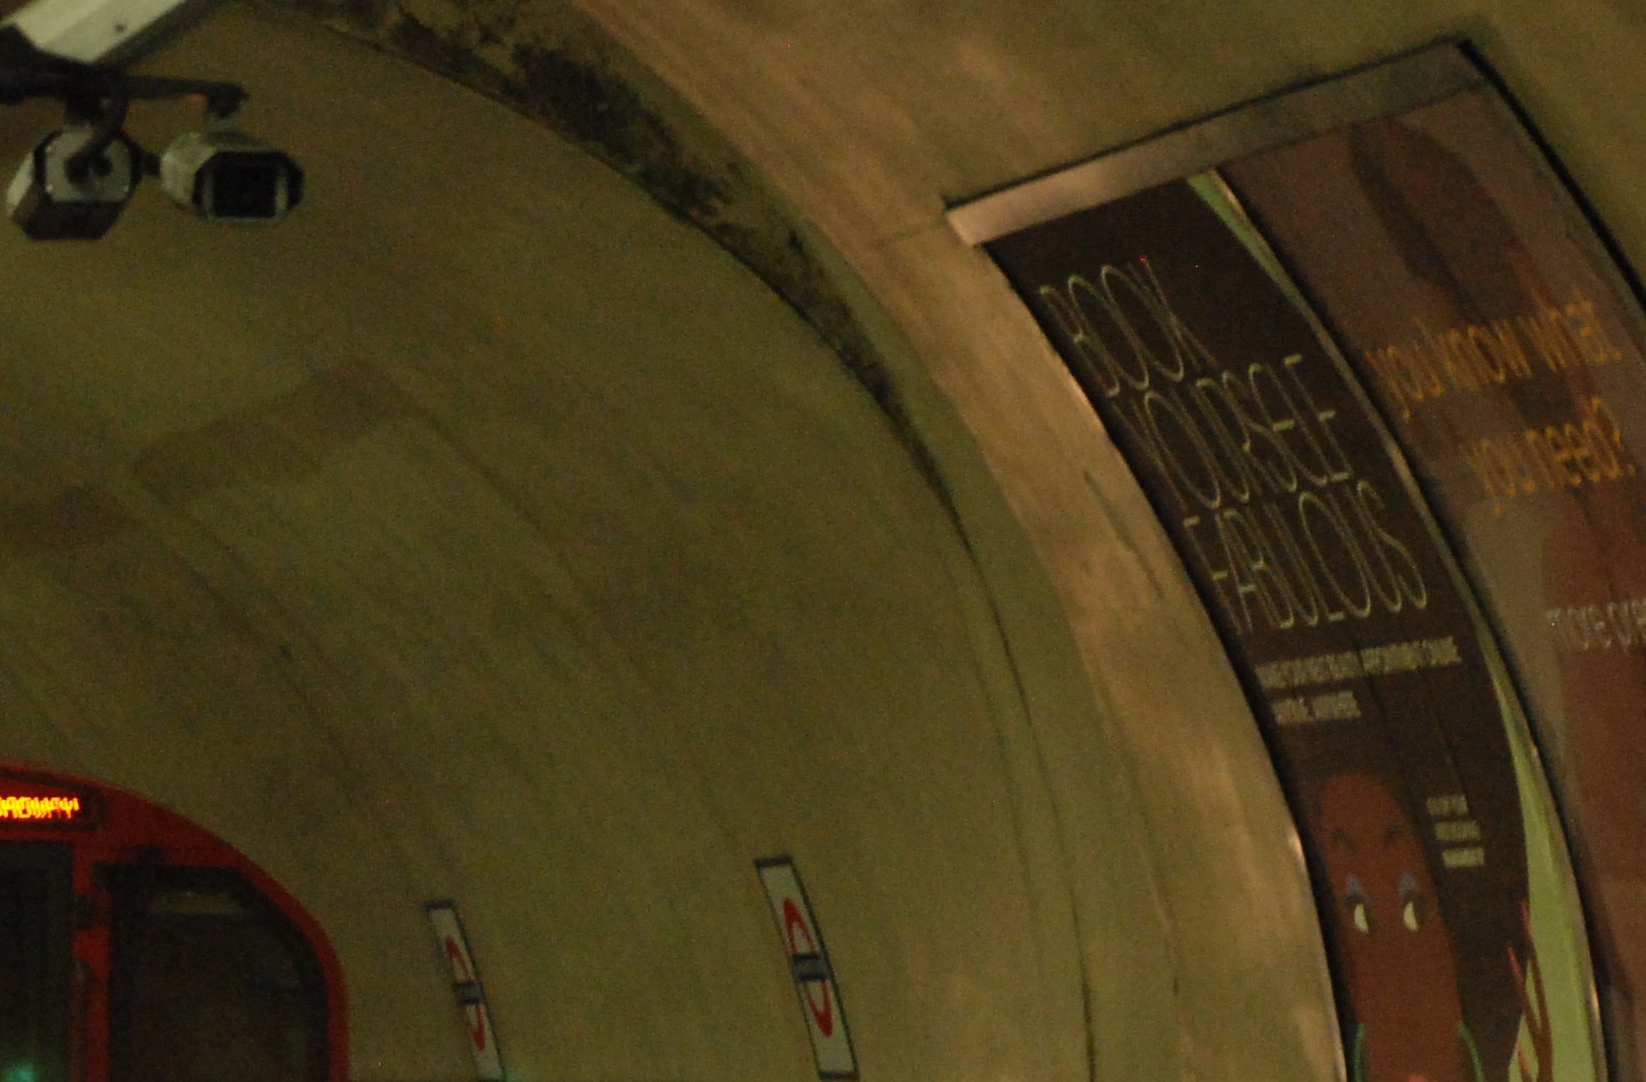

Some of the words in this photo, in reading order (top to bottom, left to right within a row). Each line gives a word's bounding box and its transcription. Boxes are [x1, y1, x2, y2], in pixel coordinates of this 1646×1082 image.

[1040, 256, 1220, 398] BOOK
[1111, 355, 1350, 508] YOURSELF
[1184, 480, 1427, 635] FABULOUS
